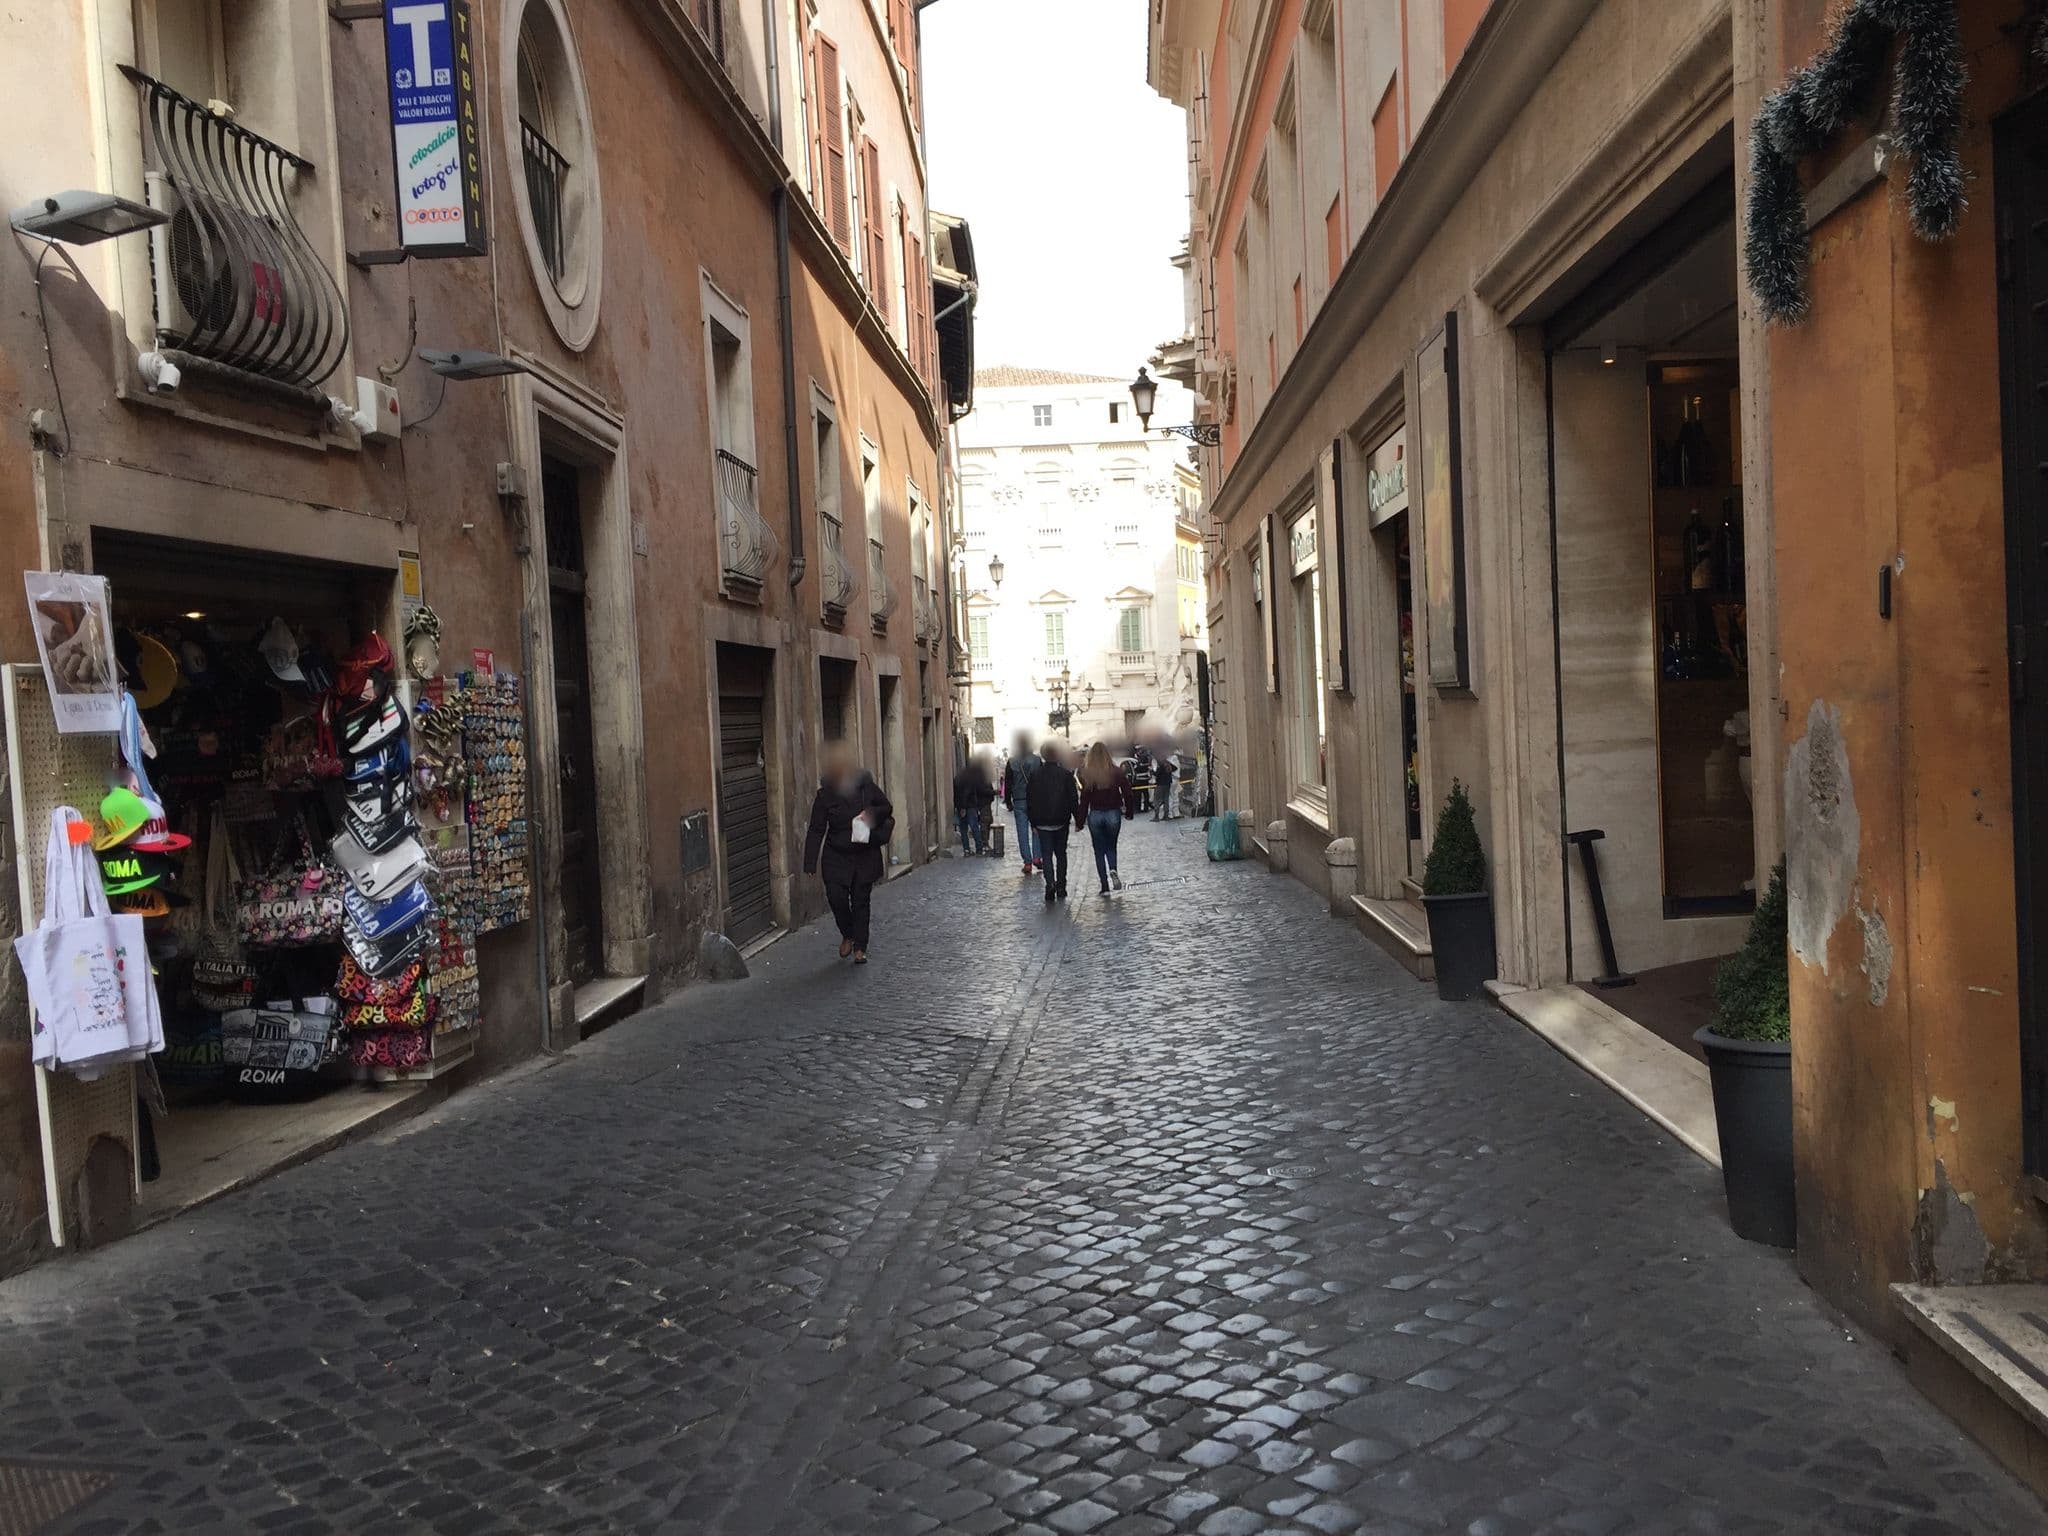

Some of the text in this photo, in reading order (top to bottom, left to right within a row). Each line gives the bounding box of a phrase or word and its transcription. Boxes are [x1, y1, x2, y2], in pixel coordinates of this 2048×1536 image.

[392, 3, 446, 88] T
[397, 94, 452, 107] SALI E TABACCHI
[398, 106, 451, 119] VALORI BOLLATI
[457, 11, 479, 229] TABACCHI
[405, 206, 463, 225] OTTO
[102, 859, 142, 878] ROMA
[259, 901, 316, 919] ROMA
[239, 1068, 286, 1084] ROMA
